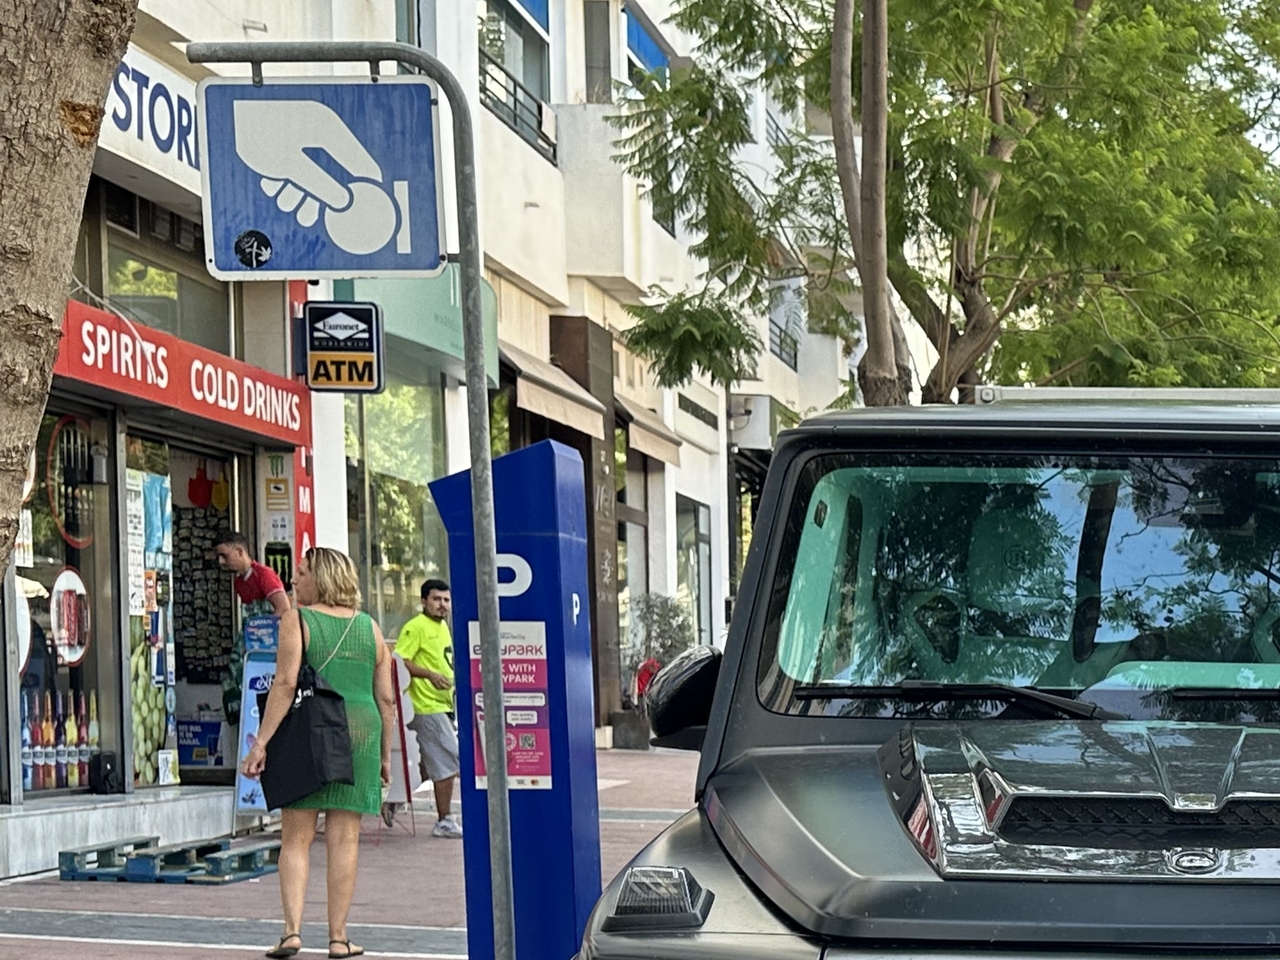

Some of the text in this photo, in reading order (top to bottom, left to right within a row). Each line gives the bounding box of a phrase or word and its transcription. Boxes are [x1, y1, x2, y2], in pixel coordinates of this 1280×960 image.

[322, 320, 360, 332] Euronet
[81, 320, 301, 432] SPIRITS COLD DRINKS
[312, 360, 374, 382] ATM
[571, 592, 581, 626] P
[508, 663, 536, 673] WITH
